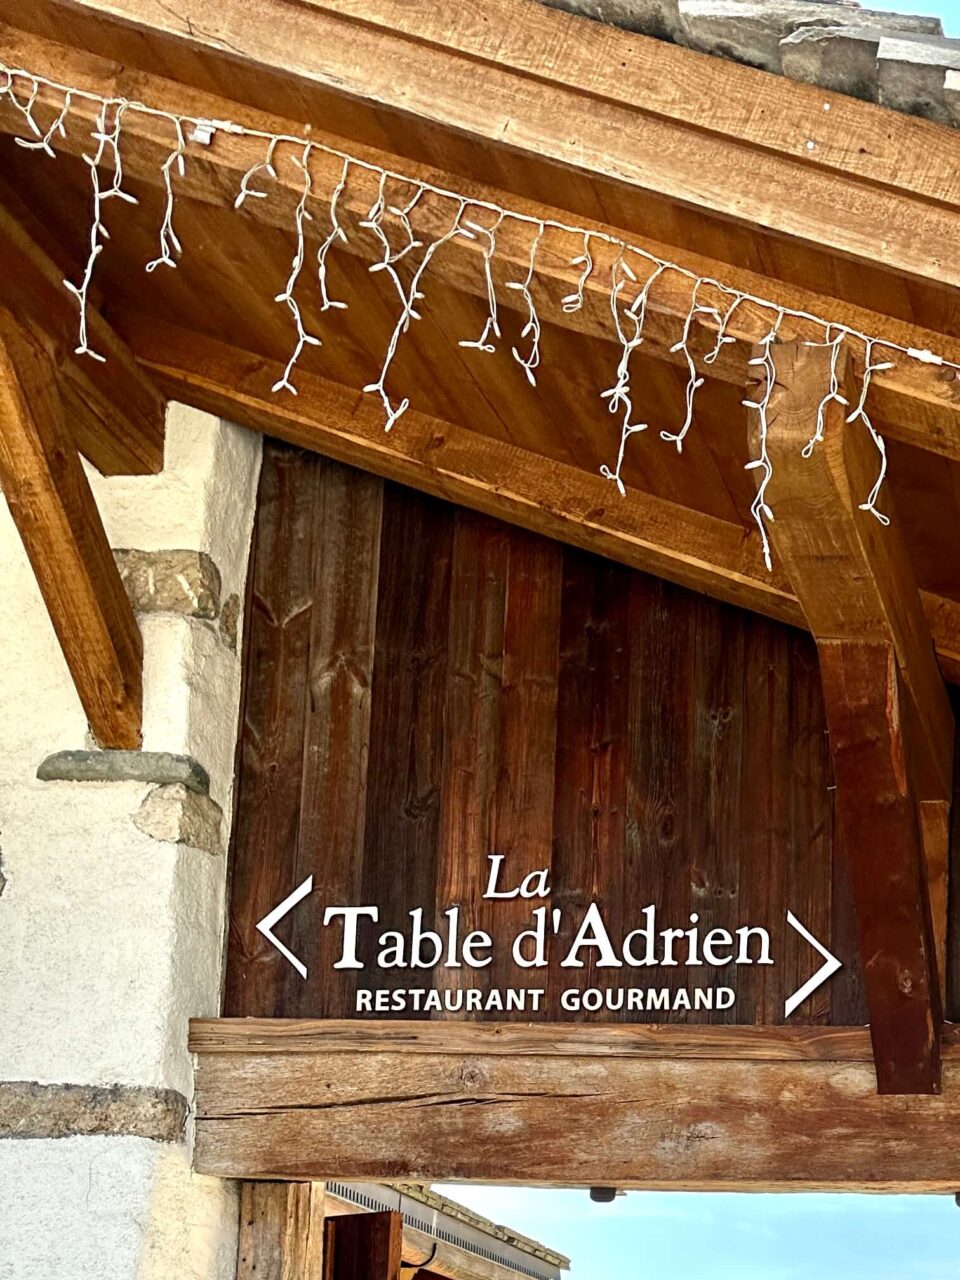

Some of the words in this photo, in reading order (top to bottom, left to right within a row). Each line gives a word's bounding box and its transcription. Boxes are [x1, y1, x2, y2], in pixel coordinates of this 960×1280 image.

[482, 853, 552, 898] La
[323, 905, 493, 969] Table
[512, 903, 775, 968] d'Adrien
[355, 988, 545, 1012] RESTAURANT
[560, 987, 737, 1011] GOURMAND
